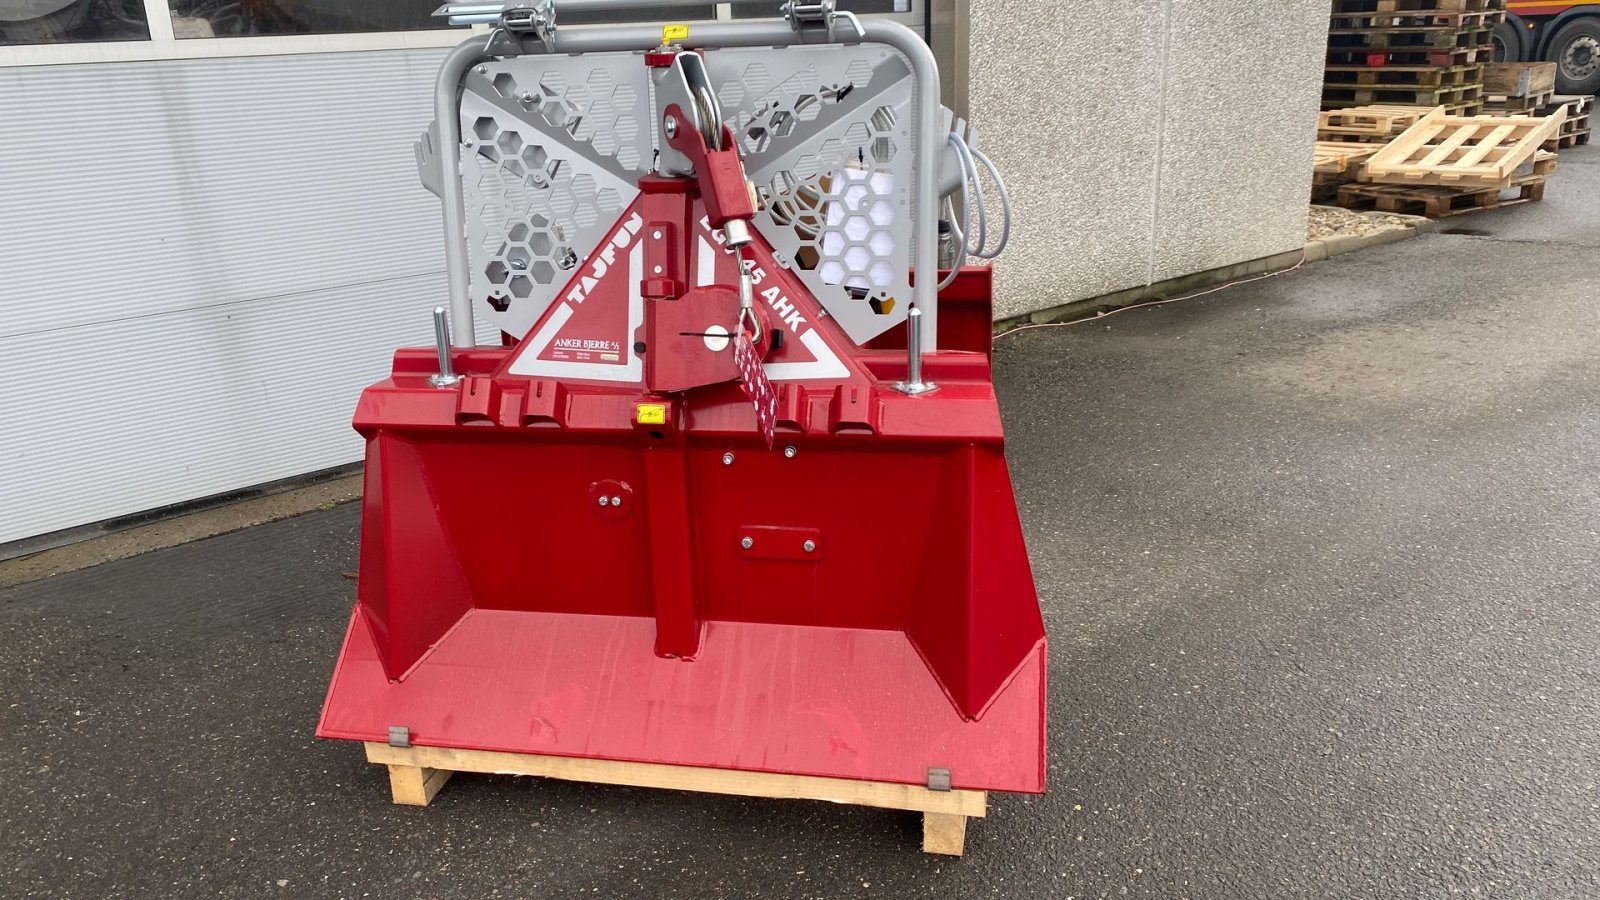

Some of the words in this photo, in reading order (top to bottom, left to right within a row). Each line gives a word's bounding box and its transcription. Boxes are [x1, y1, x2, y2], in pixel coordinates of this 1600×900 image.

[567, 211, 643, 304] TAJFUN
[761, 286, 808, 333] AHK
[554, 338, 582, 348] ANKER
[583, 339, 610, 350] BJERRE
